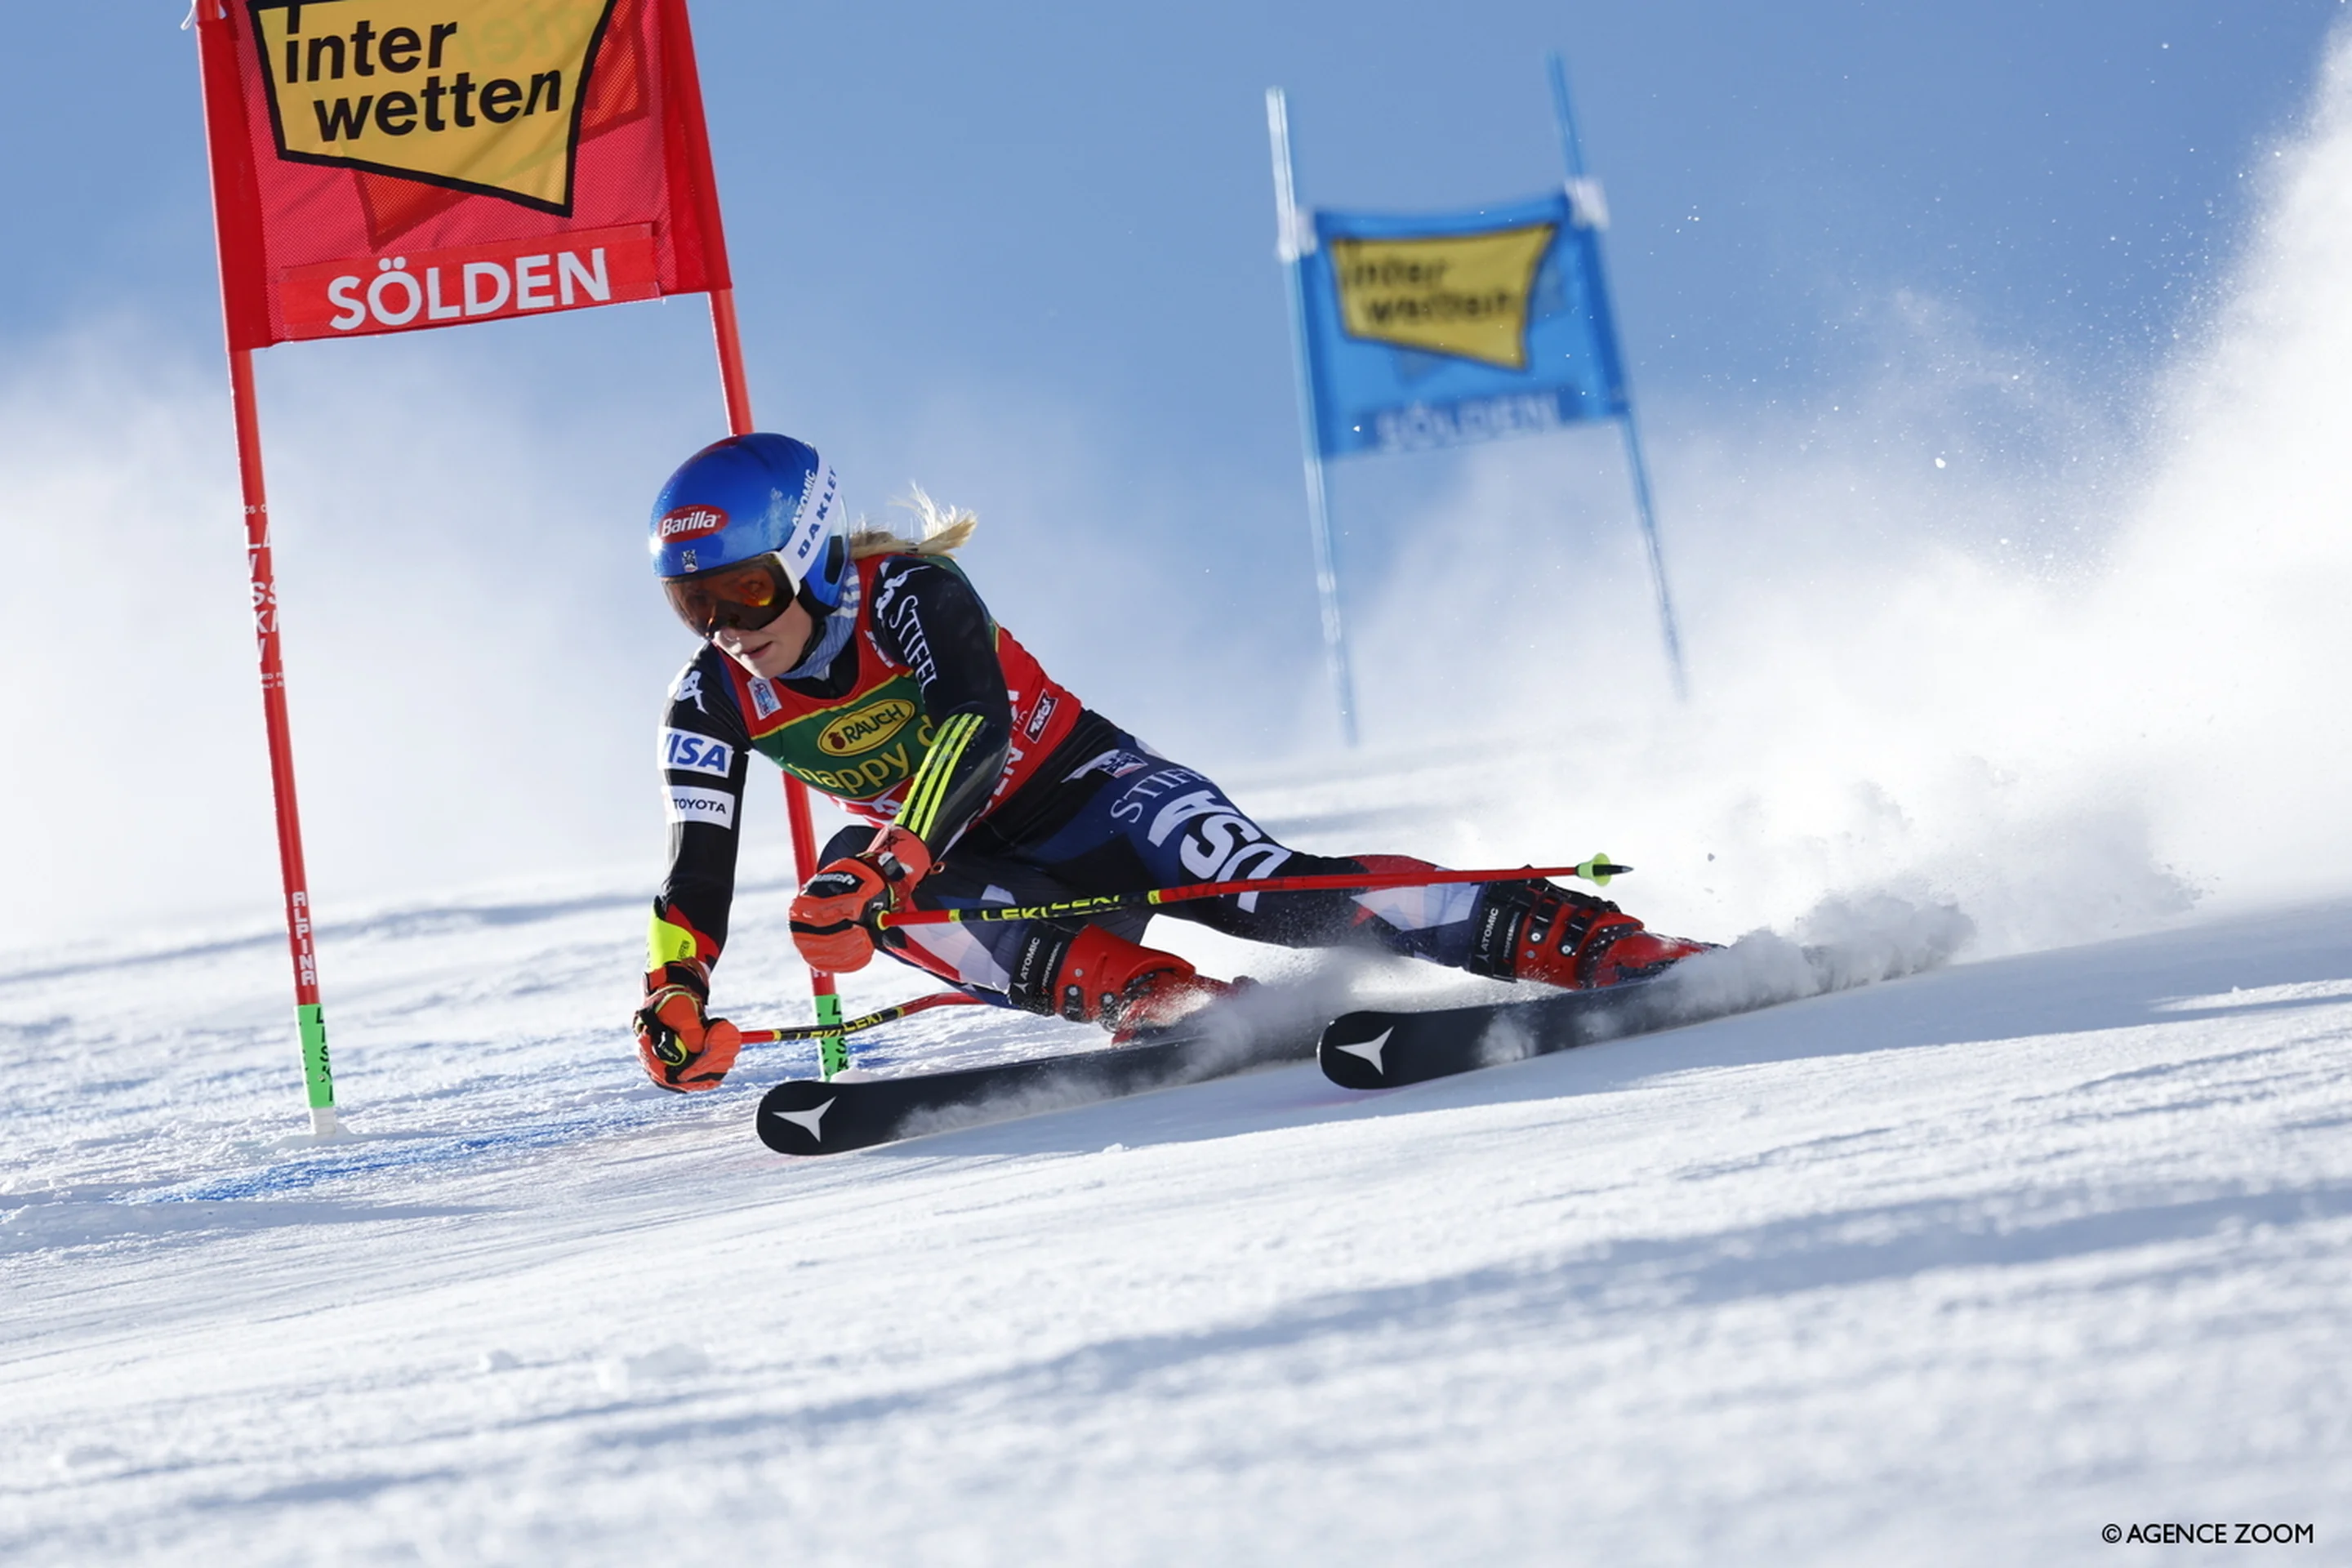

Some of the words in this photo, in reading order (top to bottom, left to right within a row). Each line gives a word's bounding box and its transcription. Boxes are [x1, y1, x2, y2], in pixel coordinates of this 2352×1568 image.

[285, 5, 457, 84] inter
[313, 69, 562, 142] wetten
[327, 247, 612, 331] SÖLDEN
[661, 510, 718, 537] Barilla
[841, 704, 906, 745] RAUCH
[666, 733, 727, 773] ISA
[672, 798, 727, 815] TOYOTA
[292, 891, 317, 986] ALPINA
[1481, 907, 1499, 952] ATOMIC
[1020, 937, 1040, 981] ATOMIC
